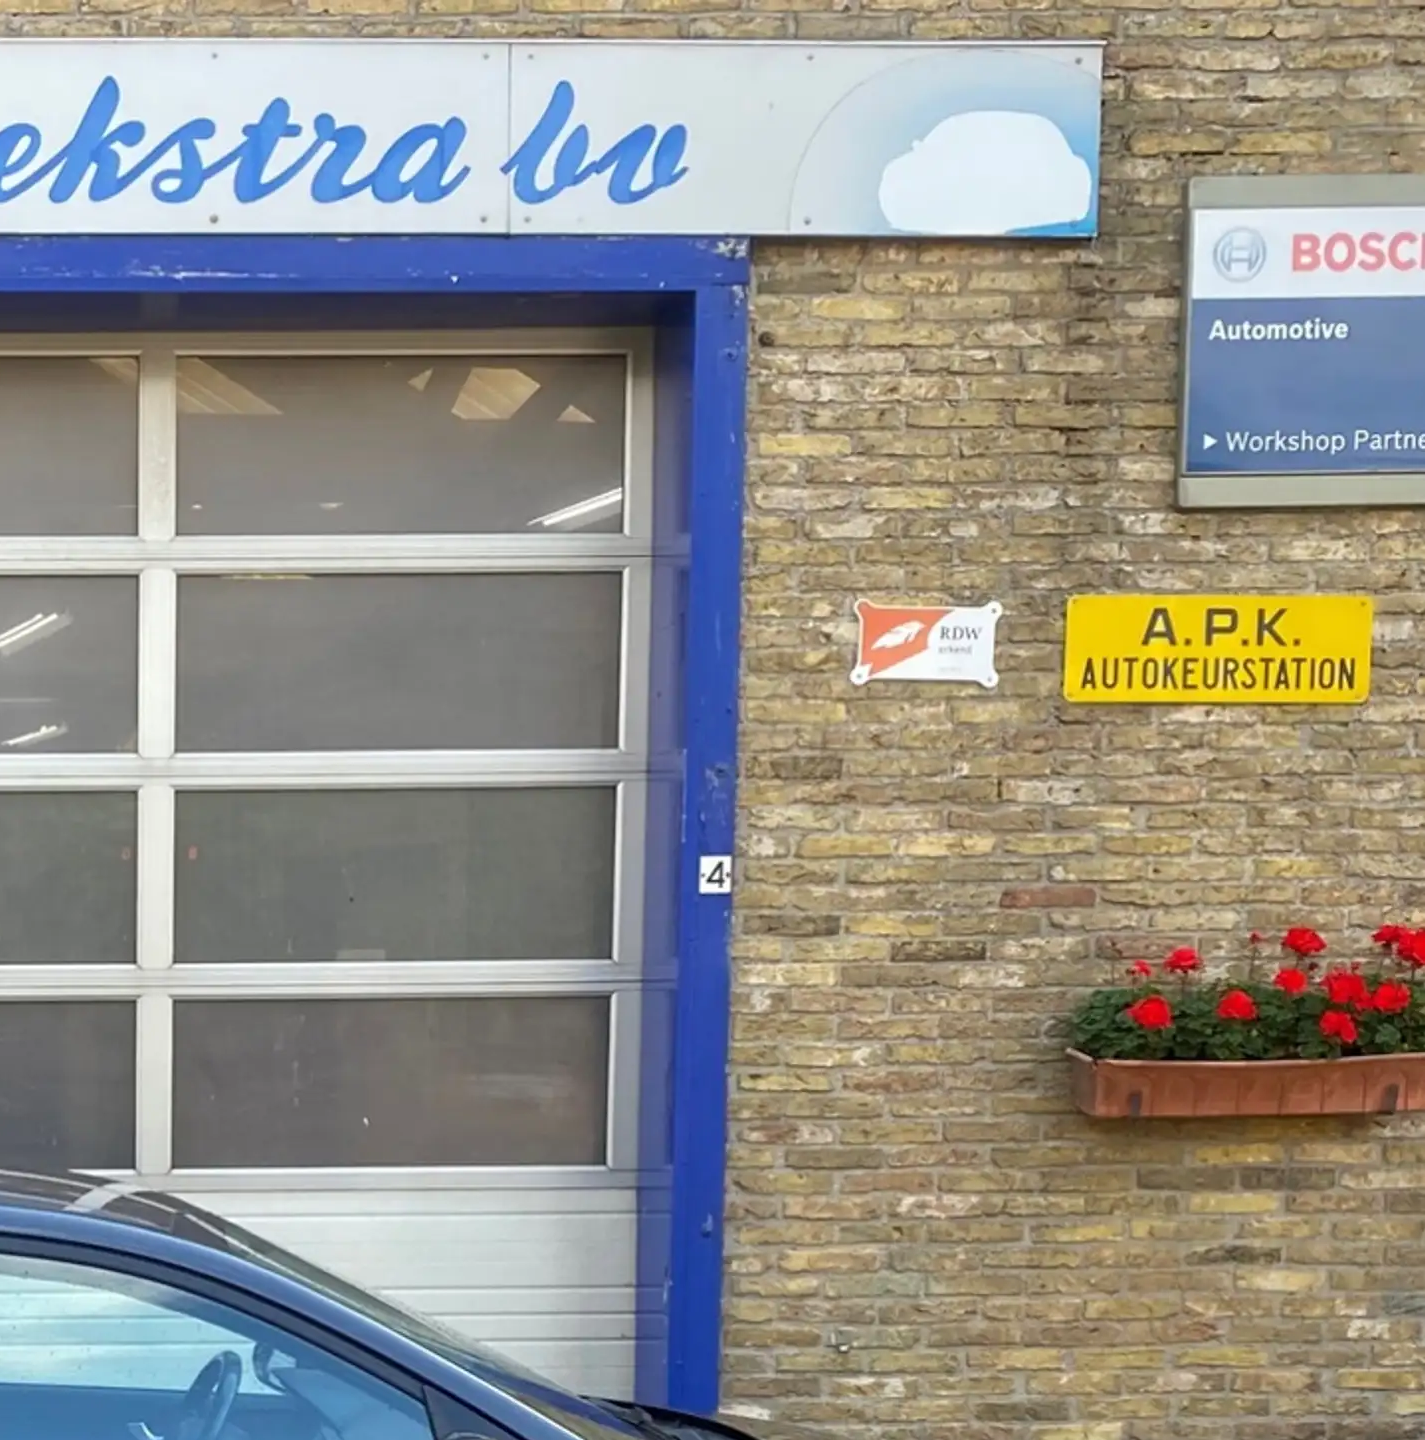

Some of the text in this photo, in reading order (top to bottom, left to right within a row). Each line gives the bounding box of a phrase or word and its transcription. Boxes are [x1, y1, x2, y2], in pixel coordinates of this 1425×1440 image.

[500, 80, 691, 201] bv
[1292, 231, 1425, 271] BOSC
[1208, 318, 1349, 340] Automotive
[1226, 430, 1345, 454] Workshop
[940, 627, 982, 640] RDW
[1141, 608, 1301, 647] A.P.K.
[1081, 657, 1356, 691] AUTOKEURSTATION
[706, 860, 726, 888] 4
